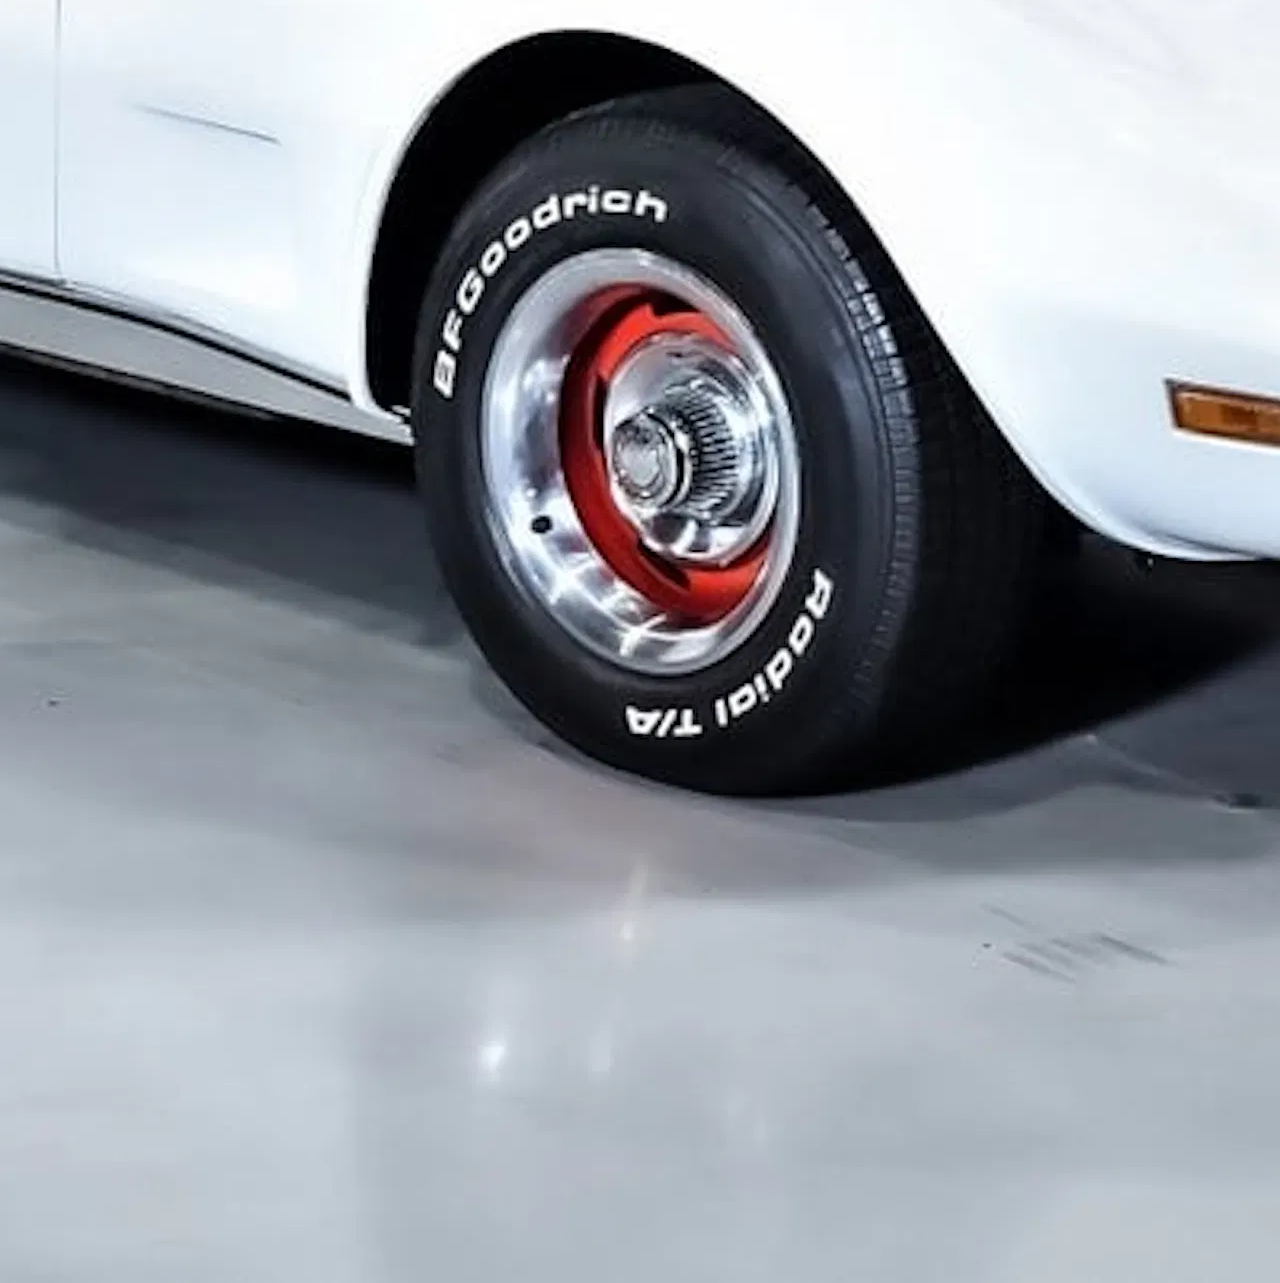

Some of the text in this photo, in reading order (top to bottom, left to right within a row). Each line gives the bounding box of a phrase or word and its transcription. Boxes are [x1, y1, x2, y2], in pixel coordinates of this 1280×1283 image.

[431, 184, 669, 399] BFGoodrich
[625, 568, 835, 738] Radial T/A
